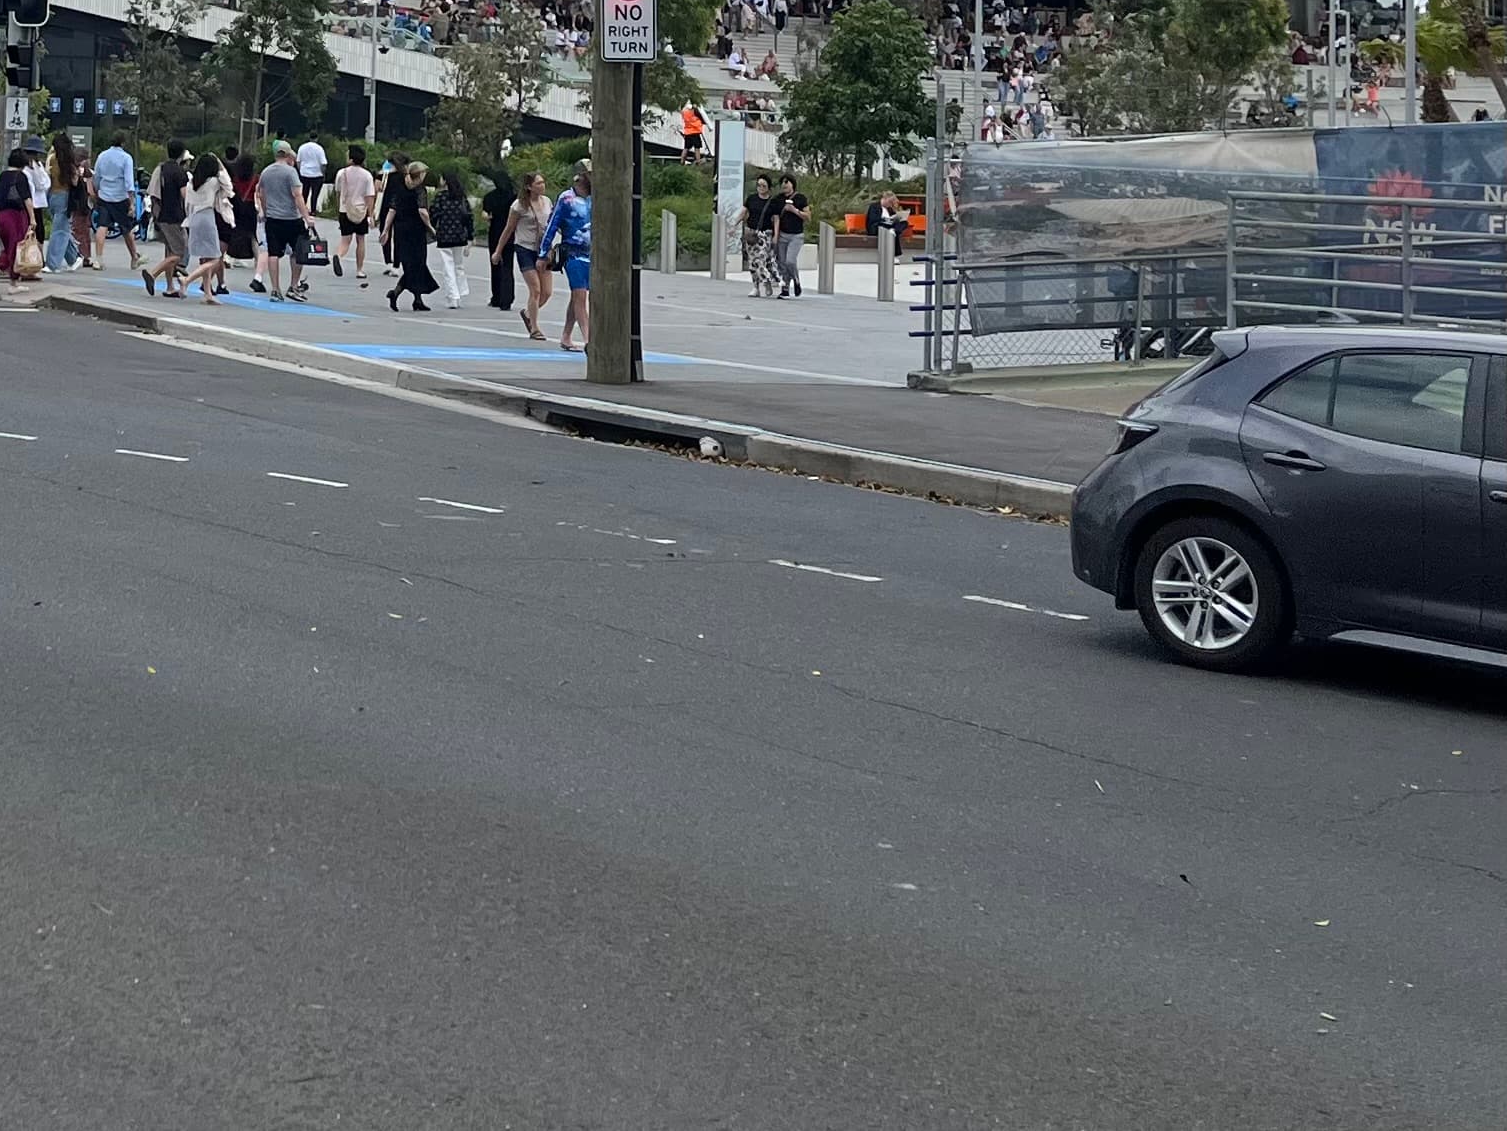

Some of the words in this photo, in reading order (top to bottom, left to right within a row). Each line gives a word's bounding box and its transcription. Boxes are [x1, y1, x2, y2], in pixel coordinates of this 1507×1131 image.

[614, 4, 643, 21] NO
[608, 25, 649, 37] RIGHT
[610, 41, 648, 53] TURN
[1362, 218, 1437, 245] NSW
